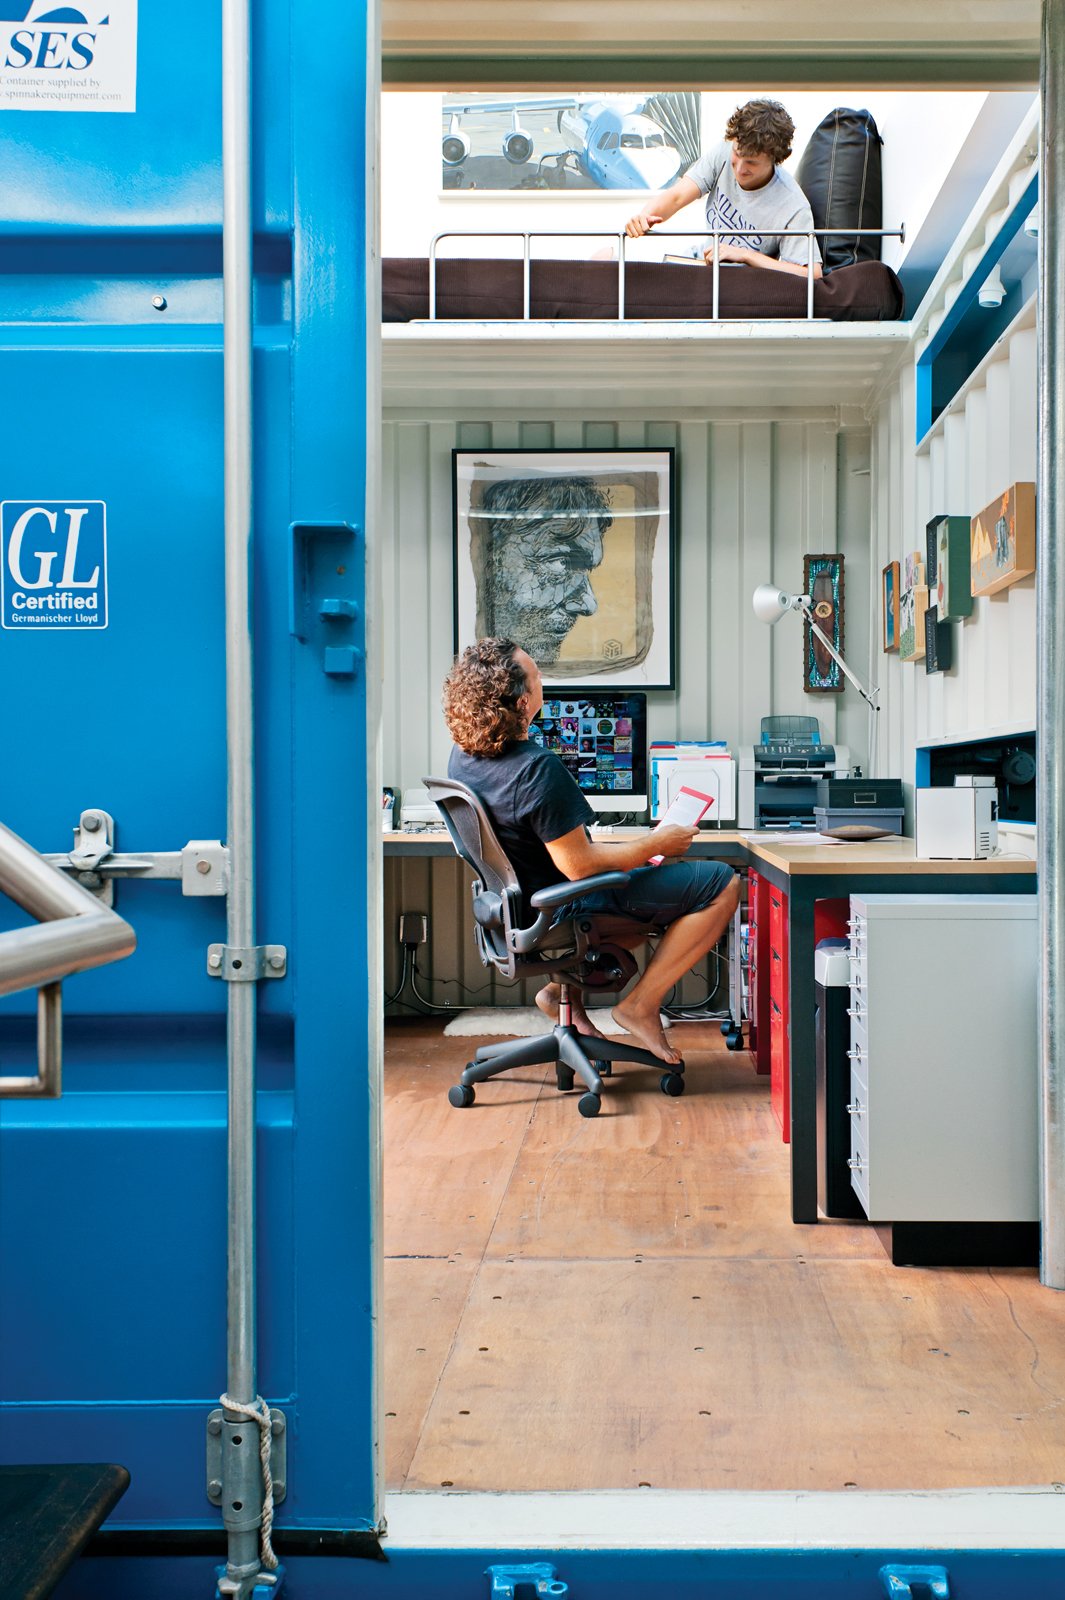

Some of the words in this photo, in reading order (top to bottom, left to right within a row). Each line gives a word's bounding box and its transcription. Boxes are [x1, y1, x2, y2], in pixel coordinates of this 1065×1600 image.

[5, 30, 97, 70] SES
[48, 77, 87, 89] supplied
[89, 77, 101, 89] by
[8, 507, 100, 590] GL
[12, 592, 98, 610] Certified
[12, 613, 72, 623] Germanischer
[75, 613, 98, 625] Lloyd
